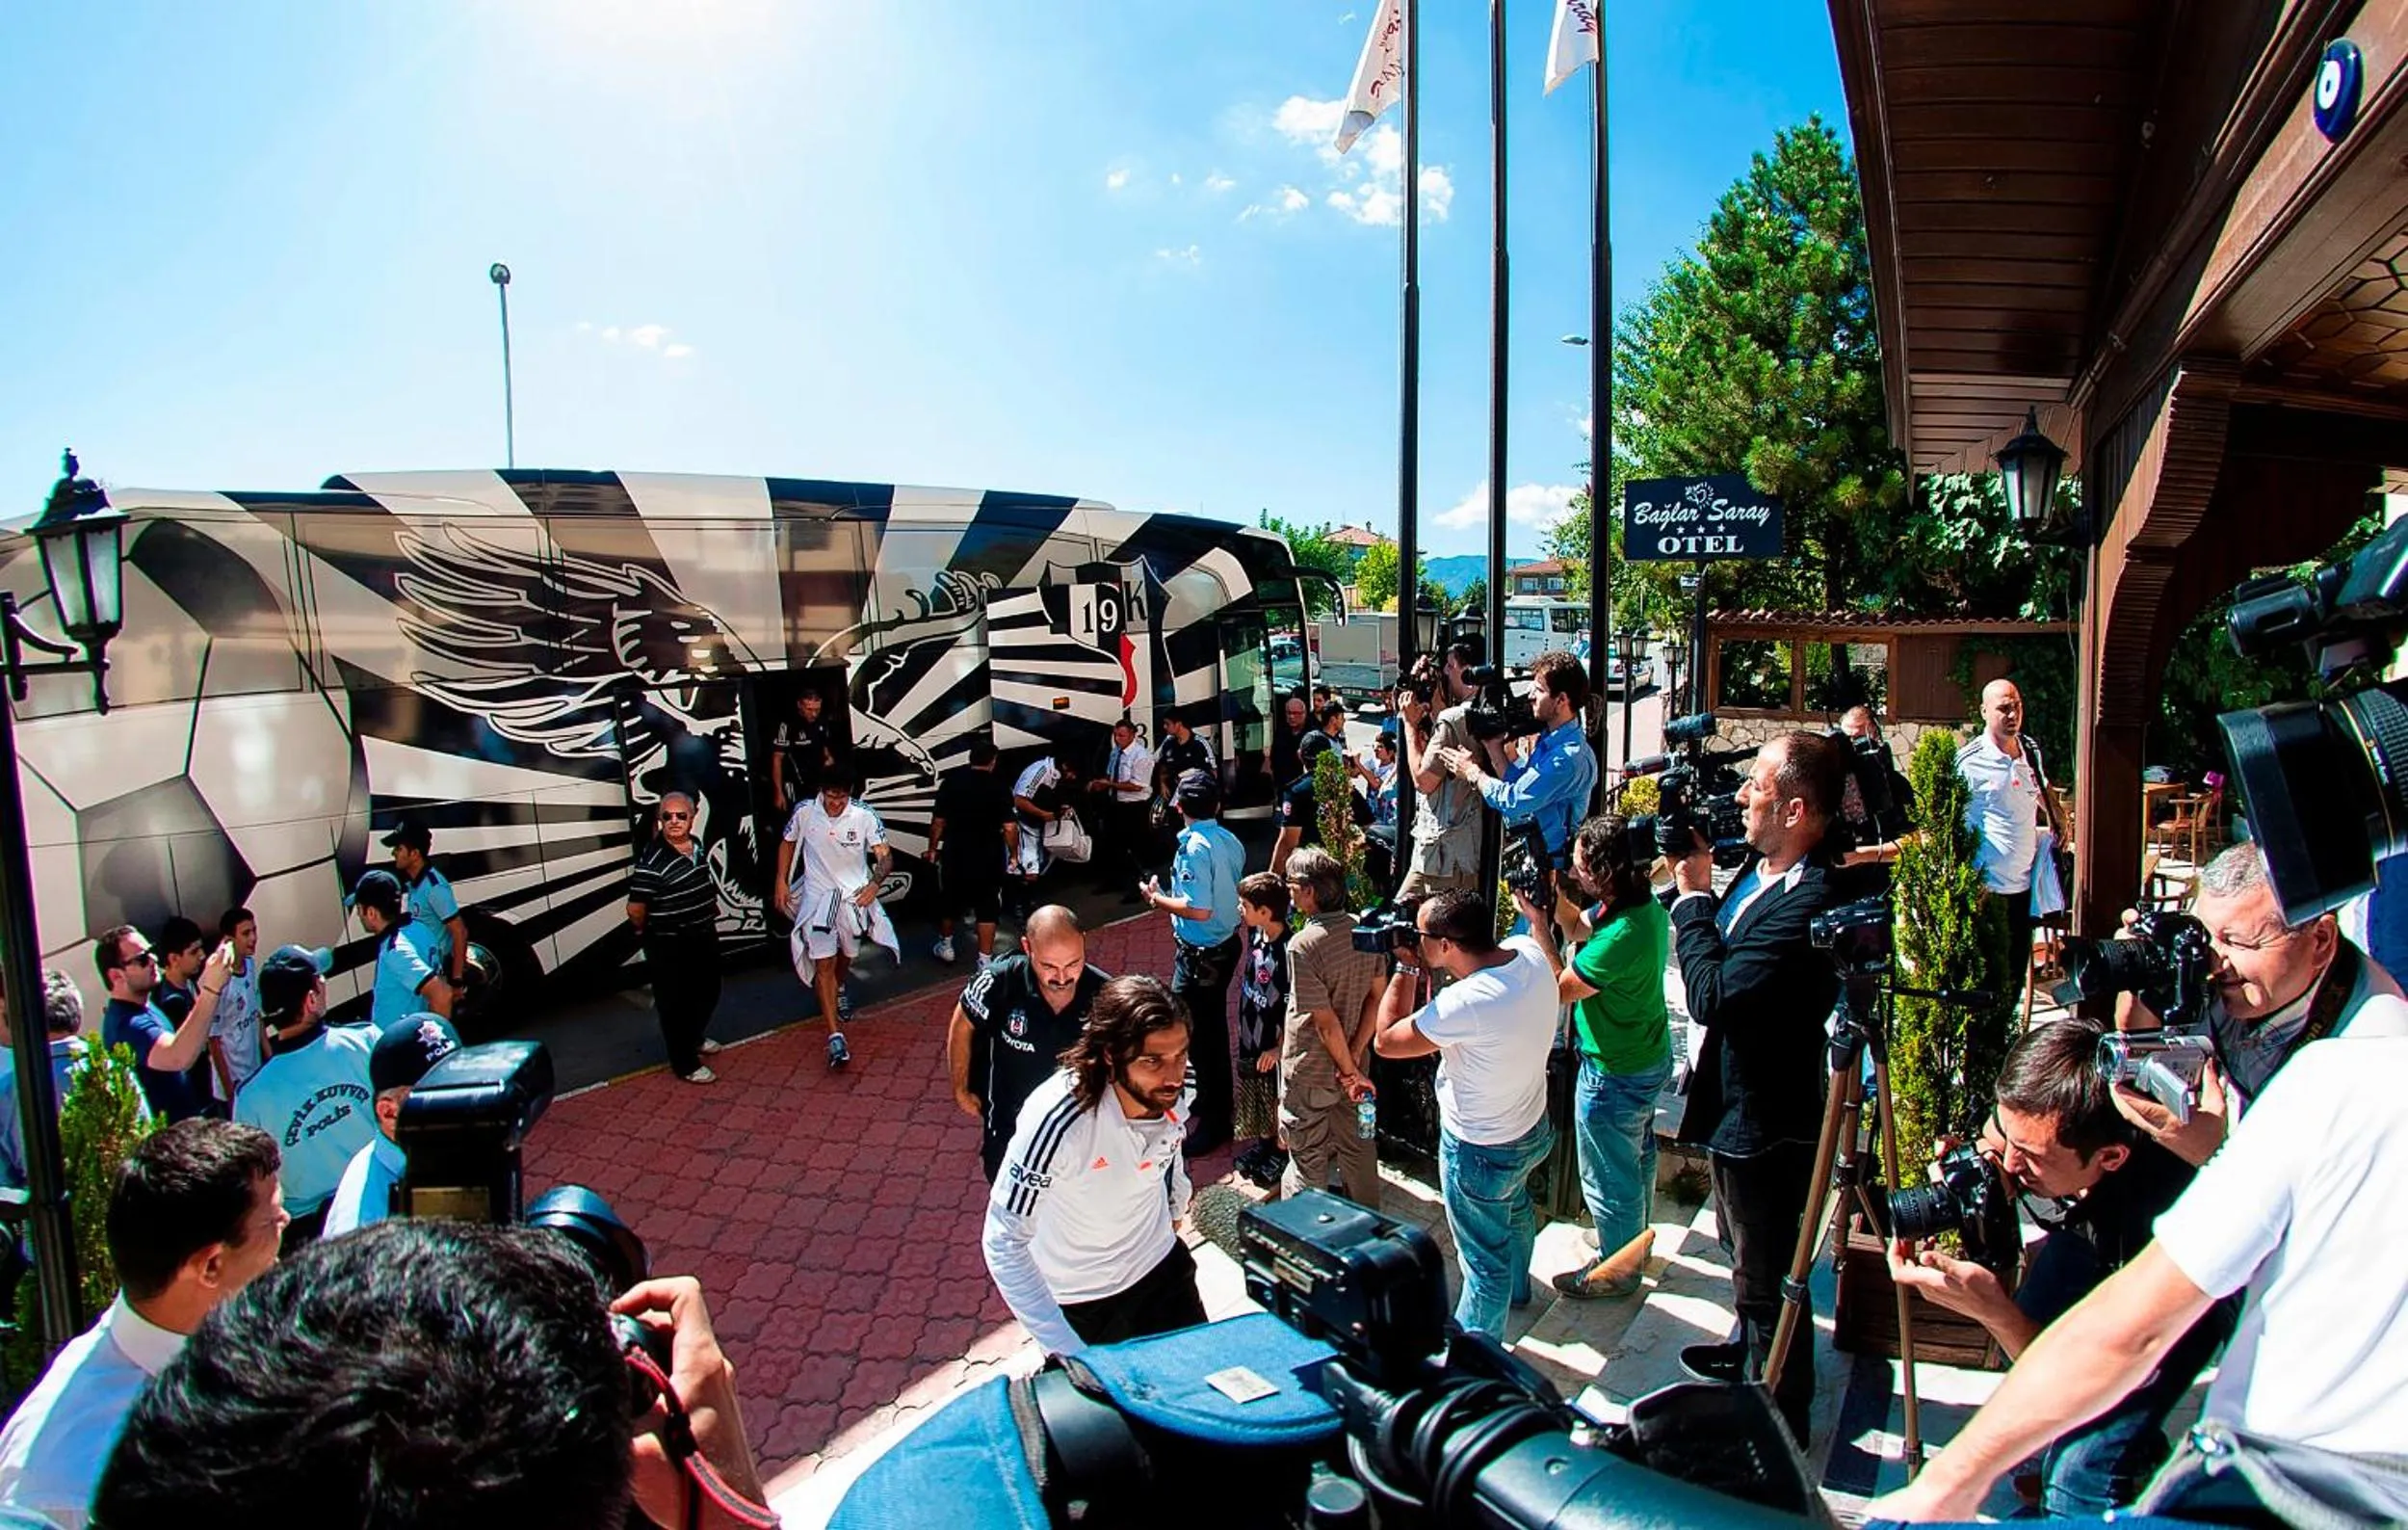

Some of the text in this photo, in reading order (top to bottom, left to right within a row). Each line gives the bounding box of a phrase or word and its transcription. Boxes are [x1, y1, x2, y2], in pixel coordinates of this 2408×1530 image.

[1634, 498, 1771, 532] Bağlar Saray
[1657, 535, 1744, 555] OTEL
[1083, 598, 1118, 634] 19
[1009, 1162, 1052, 1189] avea
